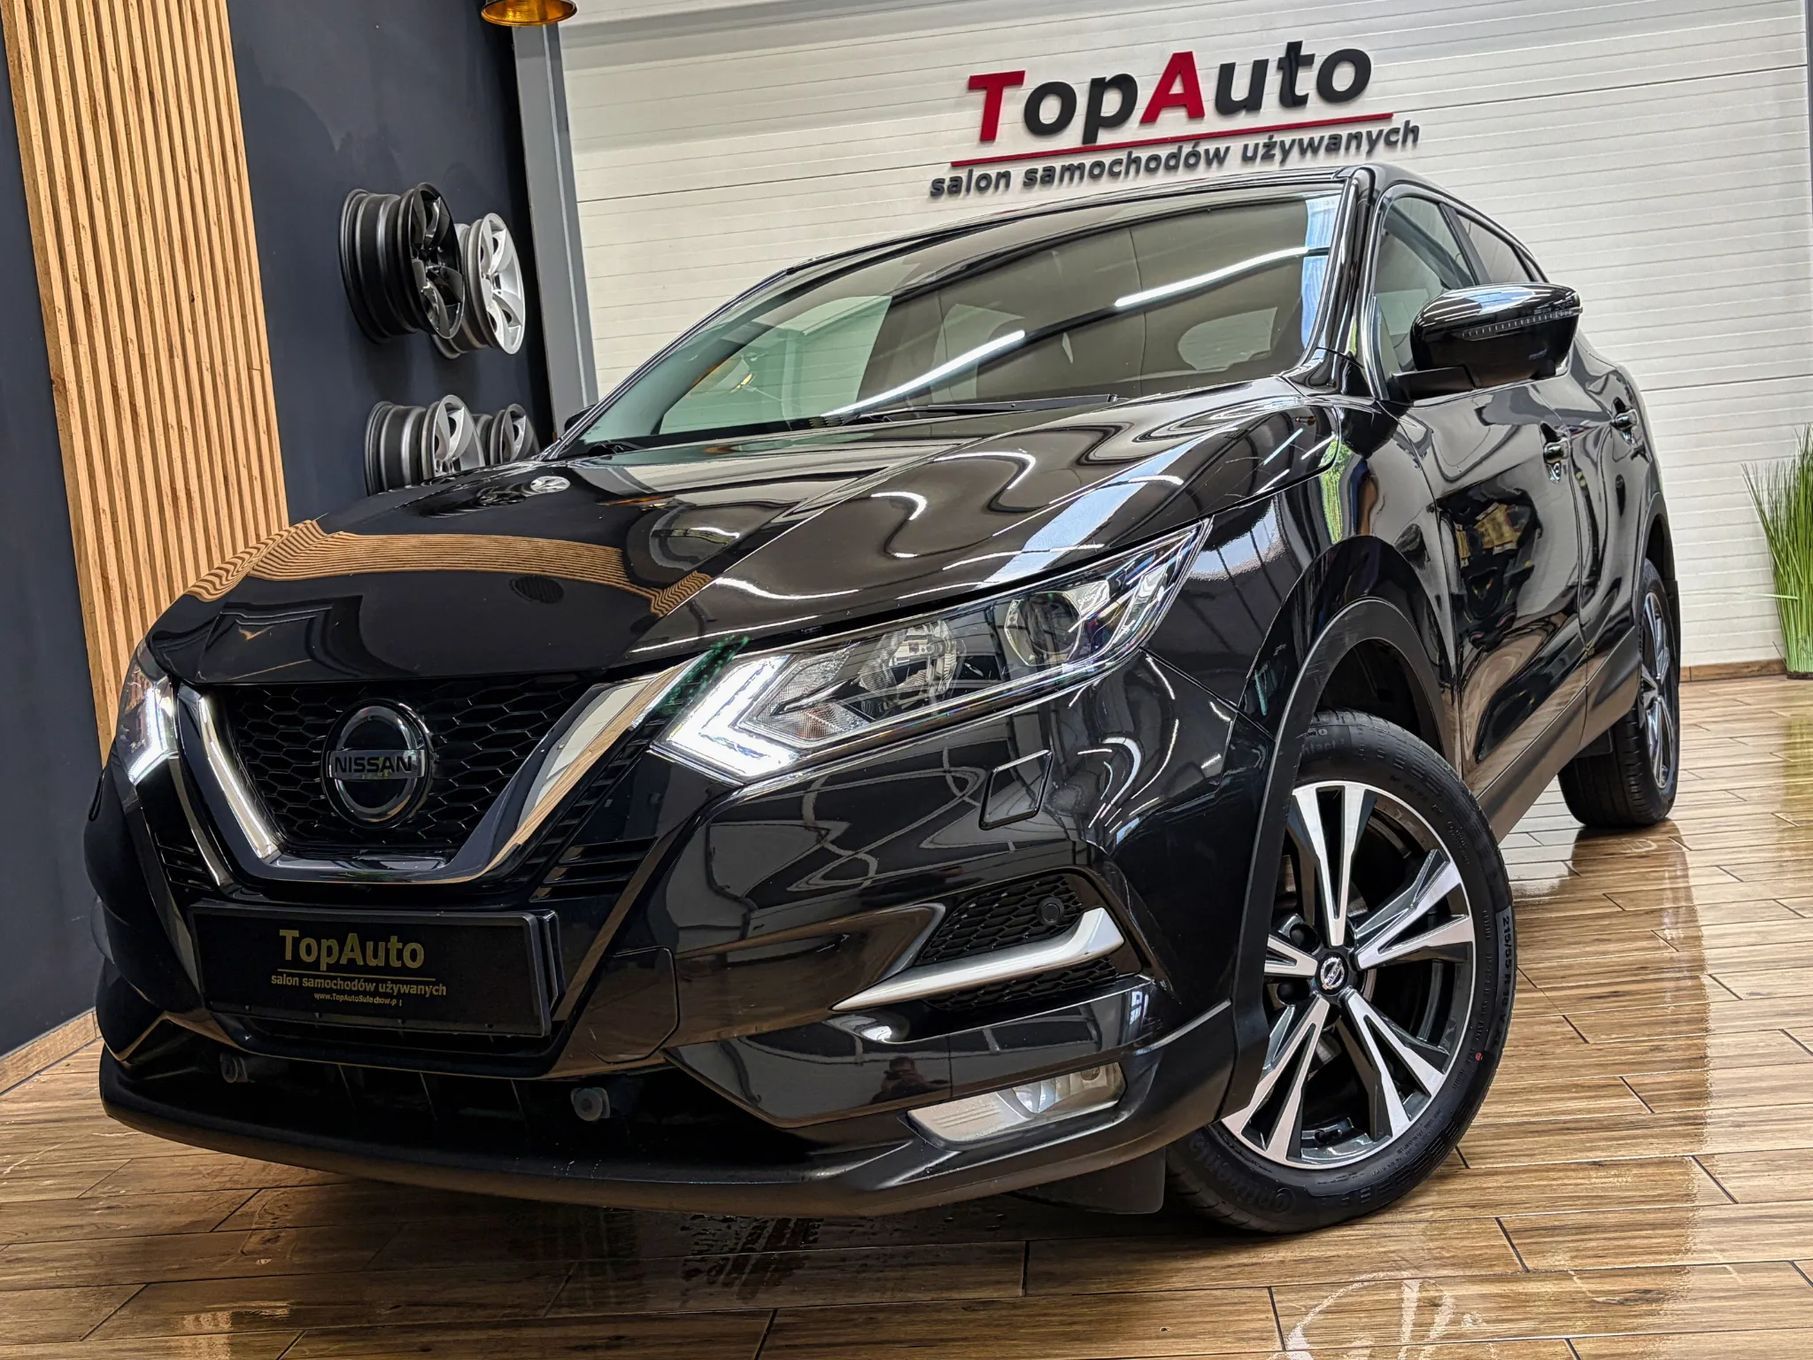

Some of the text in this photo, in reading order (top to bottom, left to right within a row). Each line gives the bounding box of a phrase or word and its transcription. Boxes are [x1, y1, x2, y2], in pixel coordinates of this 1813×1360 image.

[968, 39, 1373, 145] TopAuto
[929, 120, 1421, 198] salon samochodów używanych
[335, 755, 412, 773] NISSAN
[279, 930, 425, 971] TopAuto
[270, 973, 447, 997] salon samochodów używanych
